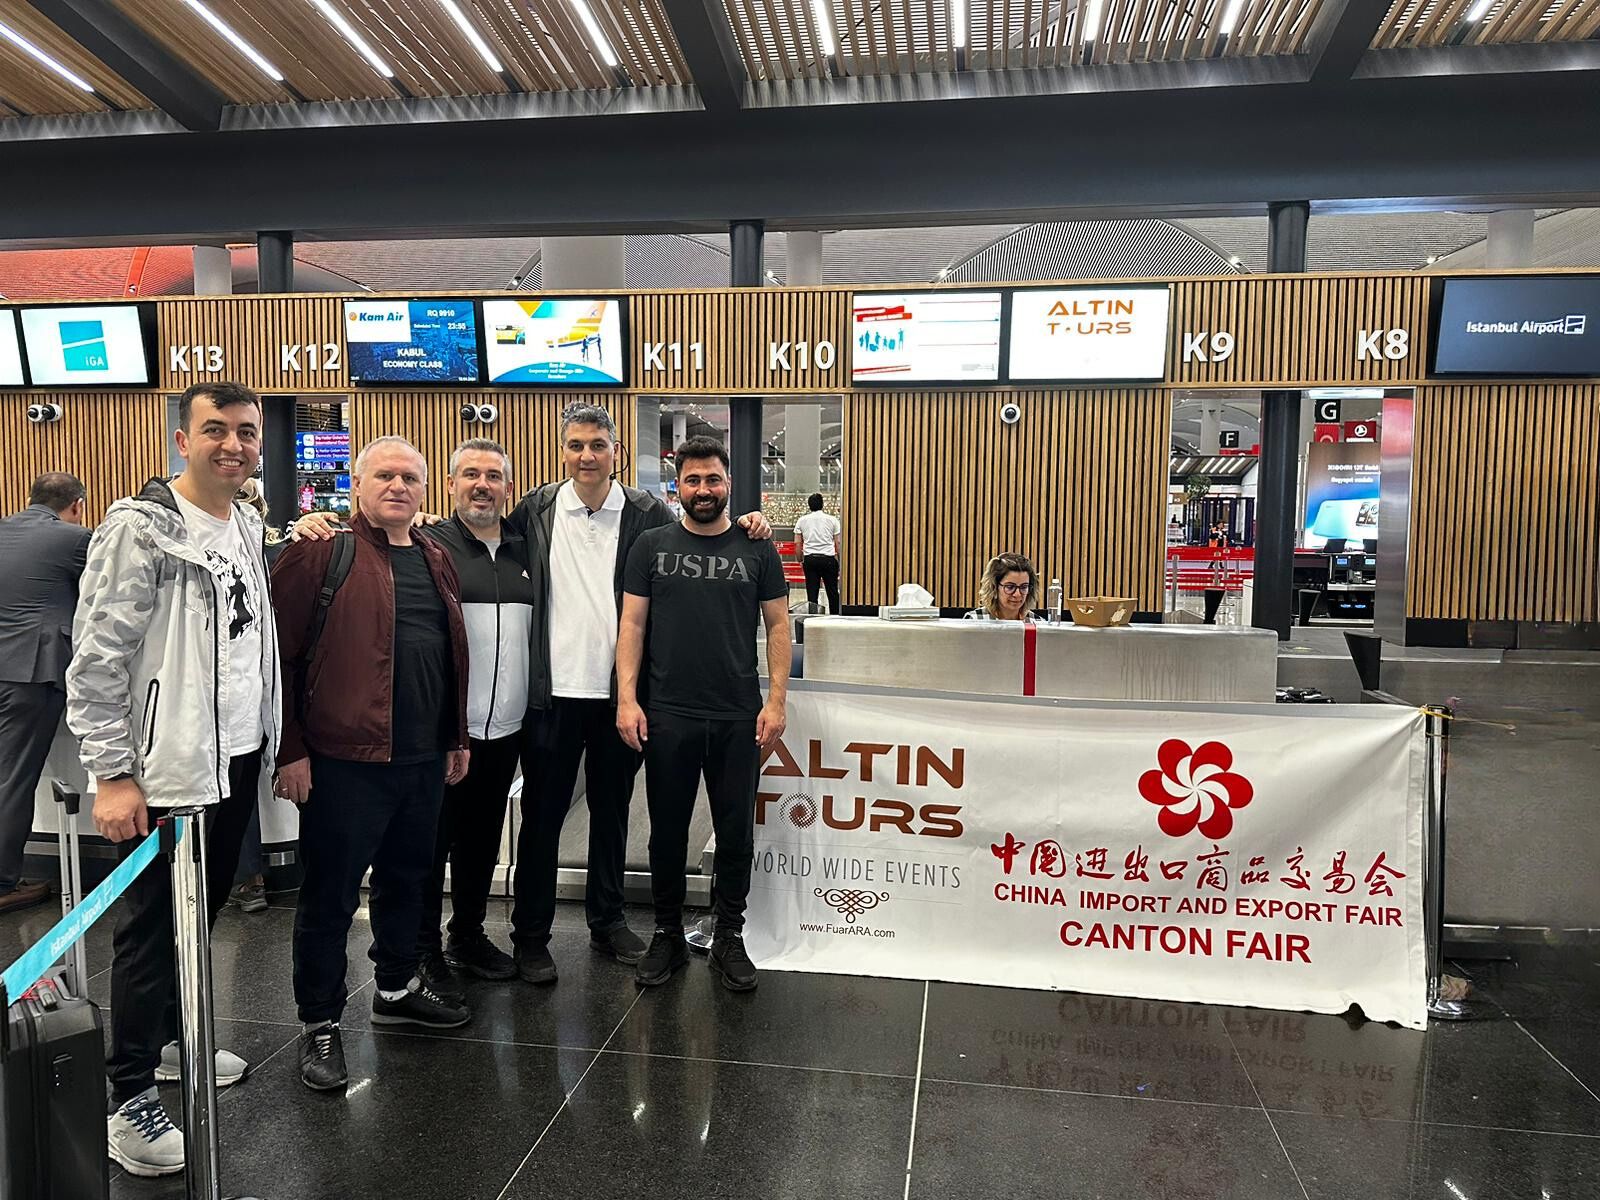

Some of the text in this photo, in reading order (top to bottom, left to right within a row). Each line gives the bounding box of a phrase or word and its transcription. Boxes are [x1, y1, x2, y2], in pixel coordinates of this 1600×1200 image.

[359, 311, 404, 322] Kam Air
[1047, 299, 1134, 316] ALTIN
[1466, 320, 1564, 335] Istanbul Airport
[170, 345, 224, 372] K13
[281, 343, 341, 372] K12
[397, 348, 427, 357] KABUL
[643, 342, 705, 371] K11
[769, 340, 836, 370] K10
[1183, 331, 1235, 362] K9
[1357, 328, 1409, 360] K8
[1321, 402, 1337, 420] G
[1225, 432, 1235, 446] F
[656, 552, 750, 582] USPA
[760, 737, 965, 790] ALTIN
[823, 857, 875, 882] WIDE
[885, 861, 961, 889] EVENTS
[994, 883, 1403, 926] CHINA IMPORT AND EXPORT FAIR
[799, 922, 896, 939] www.FuarARA.com
[1060, 921, 1312, 963] CANTON FAIR
